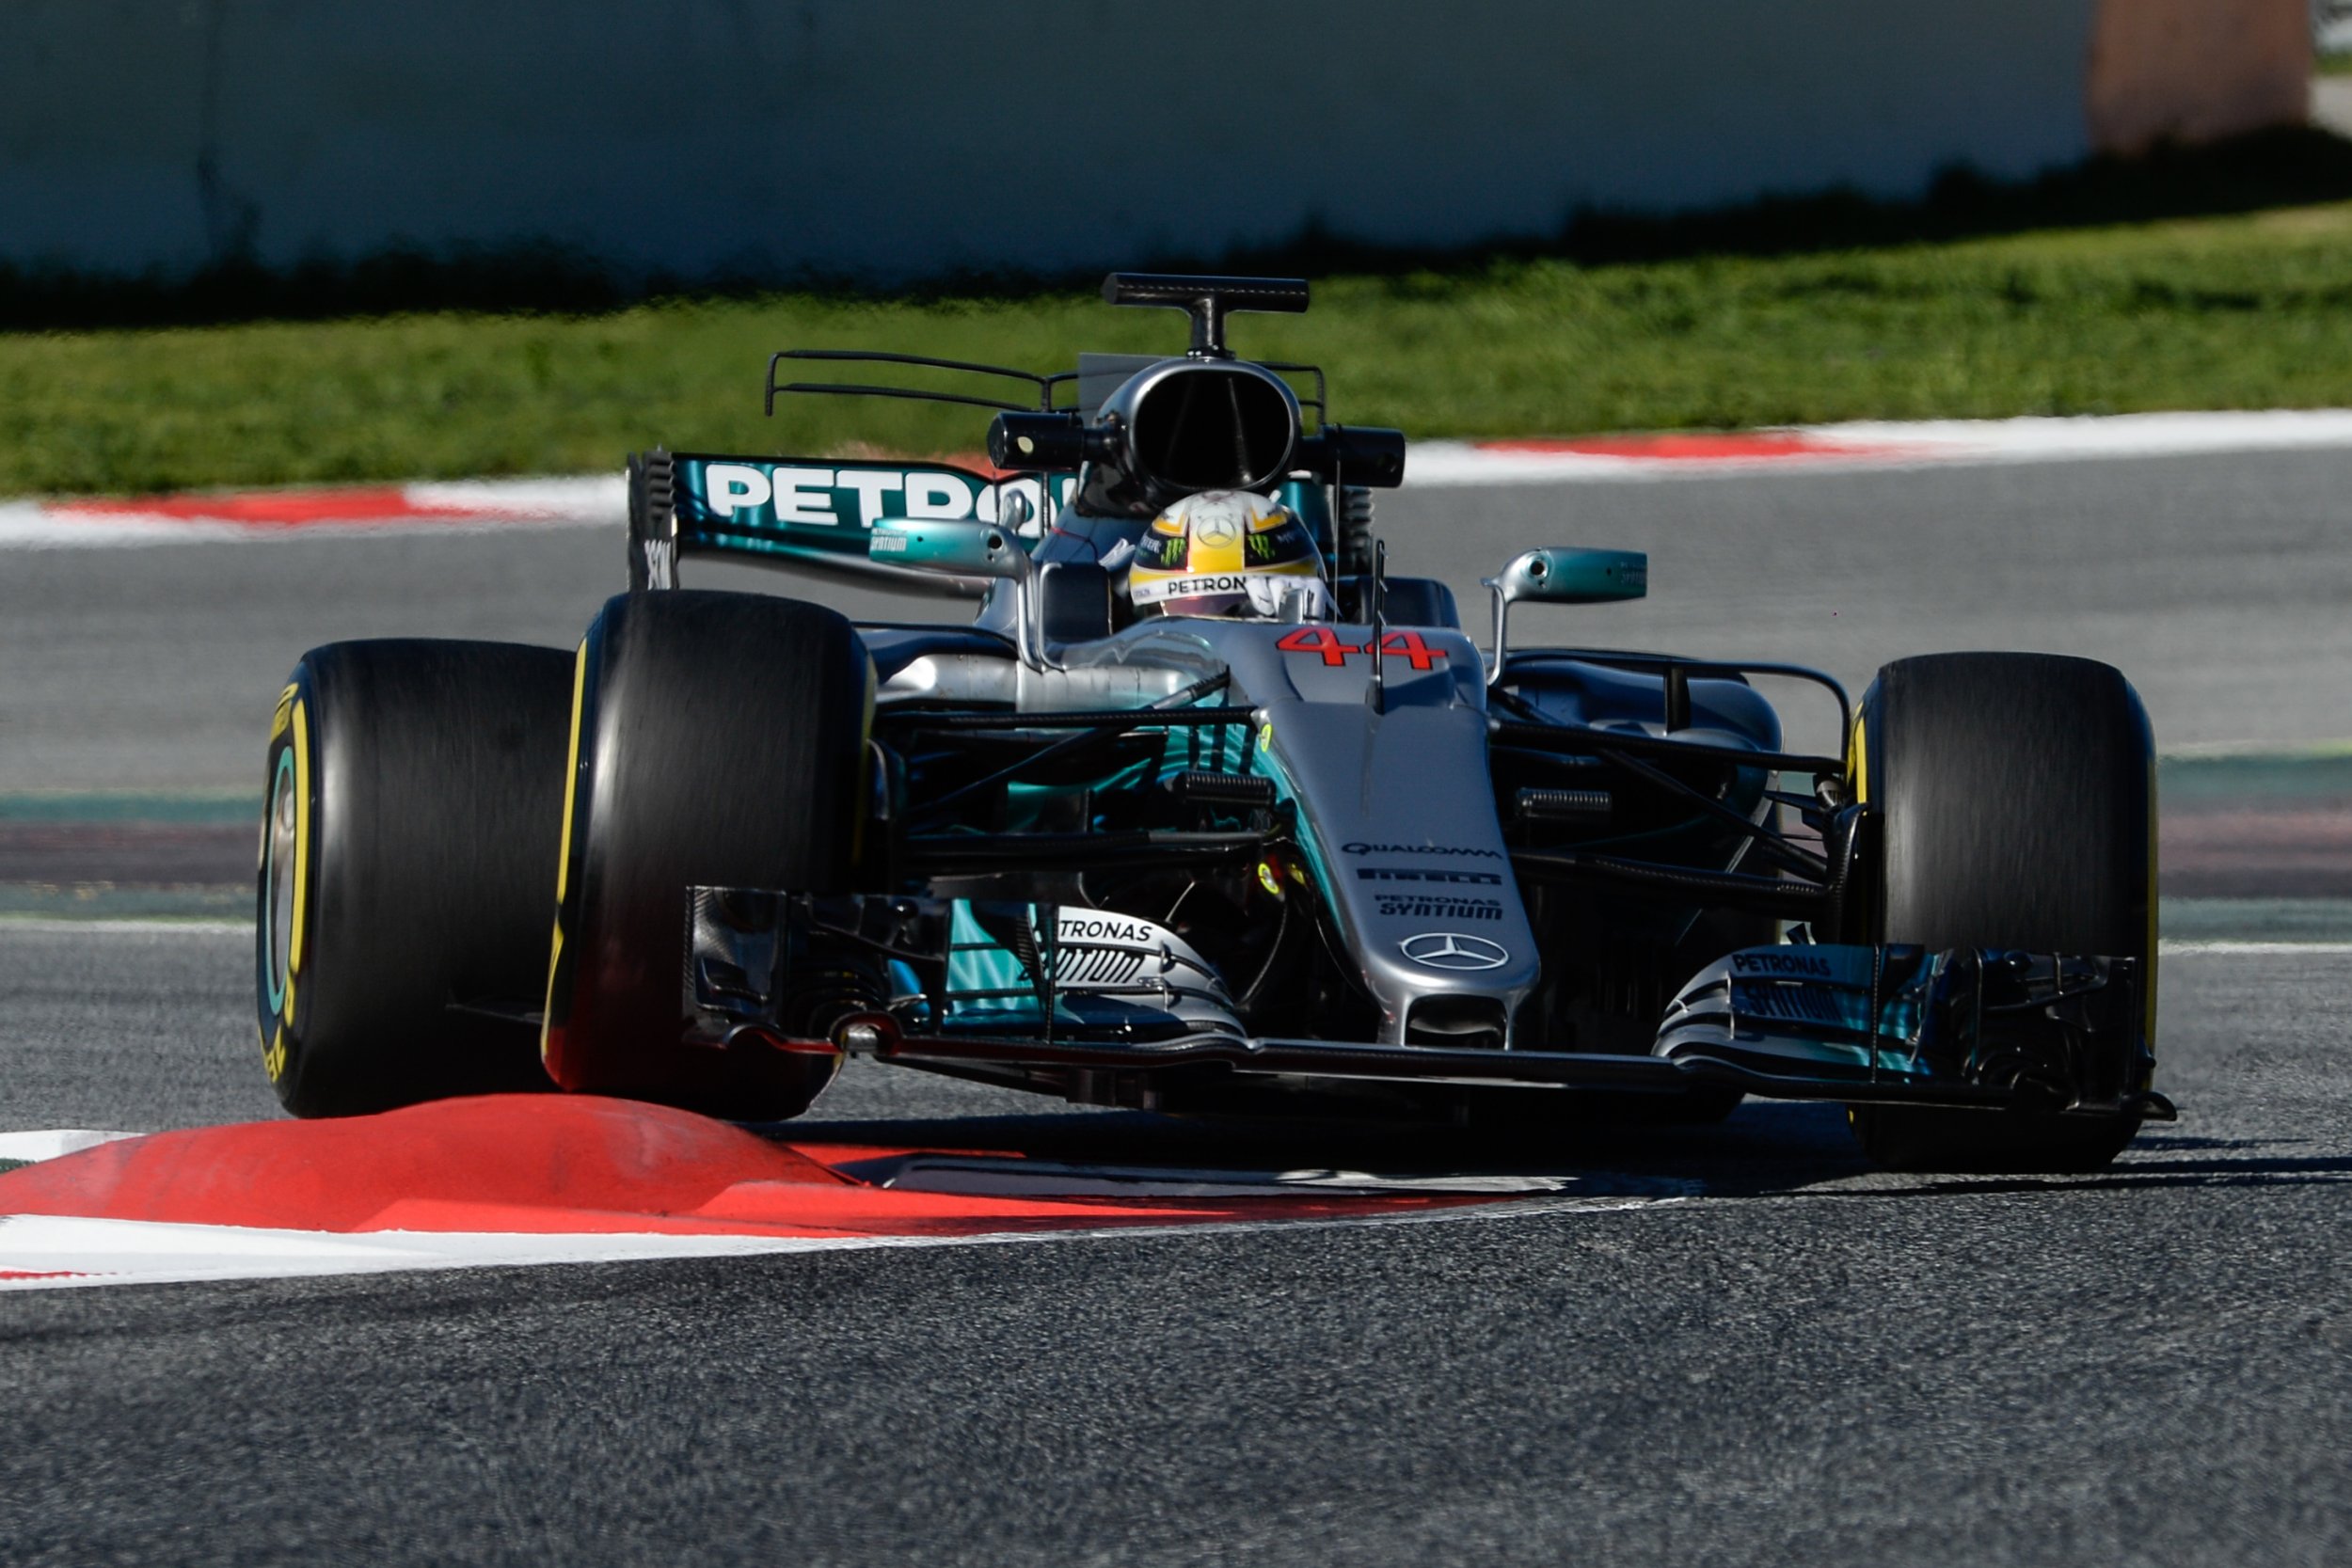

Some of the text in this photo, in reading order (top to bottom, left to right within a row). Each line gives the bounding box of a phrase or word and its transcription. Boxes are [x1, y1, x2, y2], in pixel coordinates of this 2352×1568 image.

[707, 464, 1075, 538] PETRO
[1276, 626, 1449, 671] 44
[1357, 868, 1502, 886] PIRELLI
[1375, 895, 1502, 907] PETRONAS
[1379, 903, 1503, 921] SYNTIUM
[1731, 953, 1832, 976] PETRONAS
